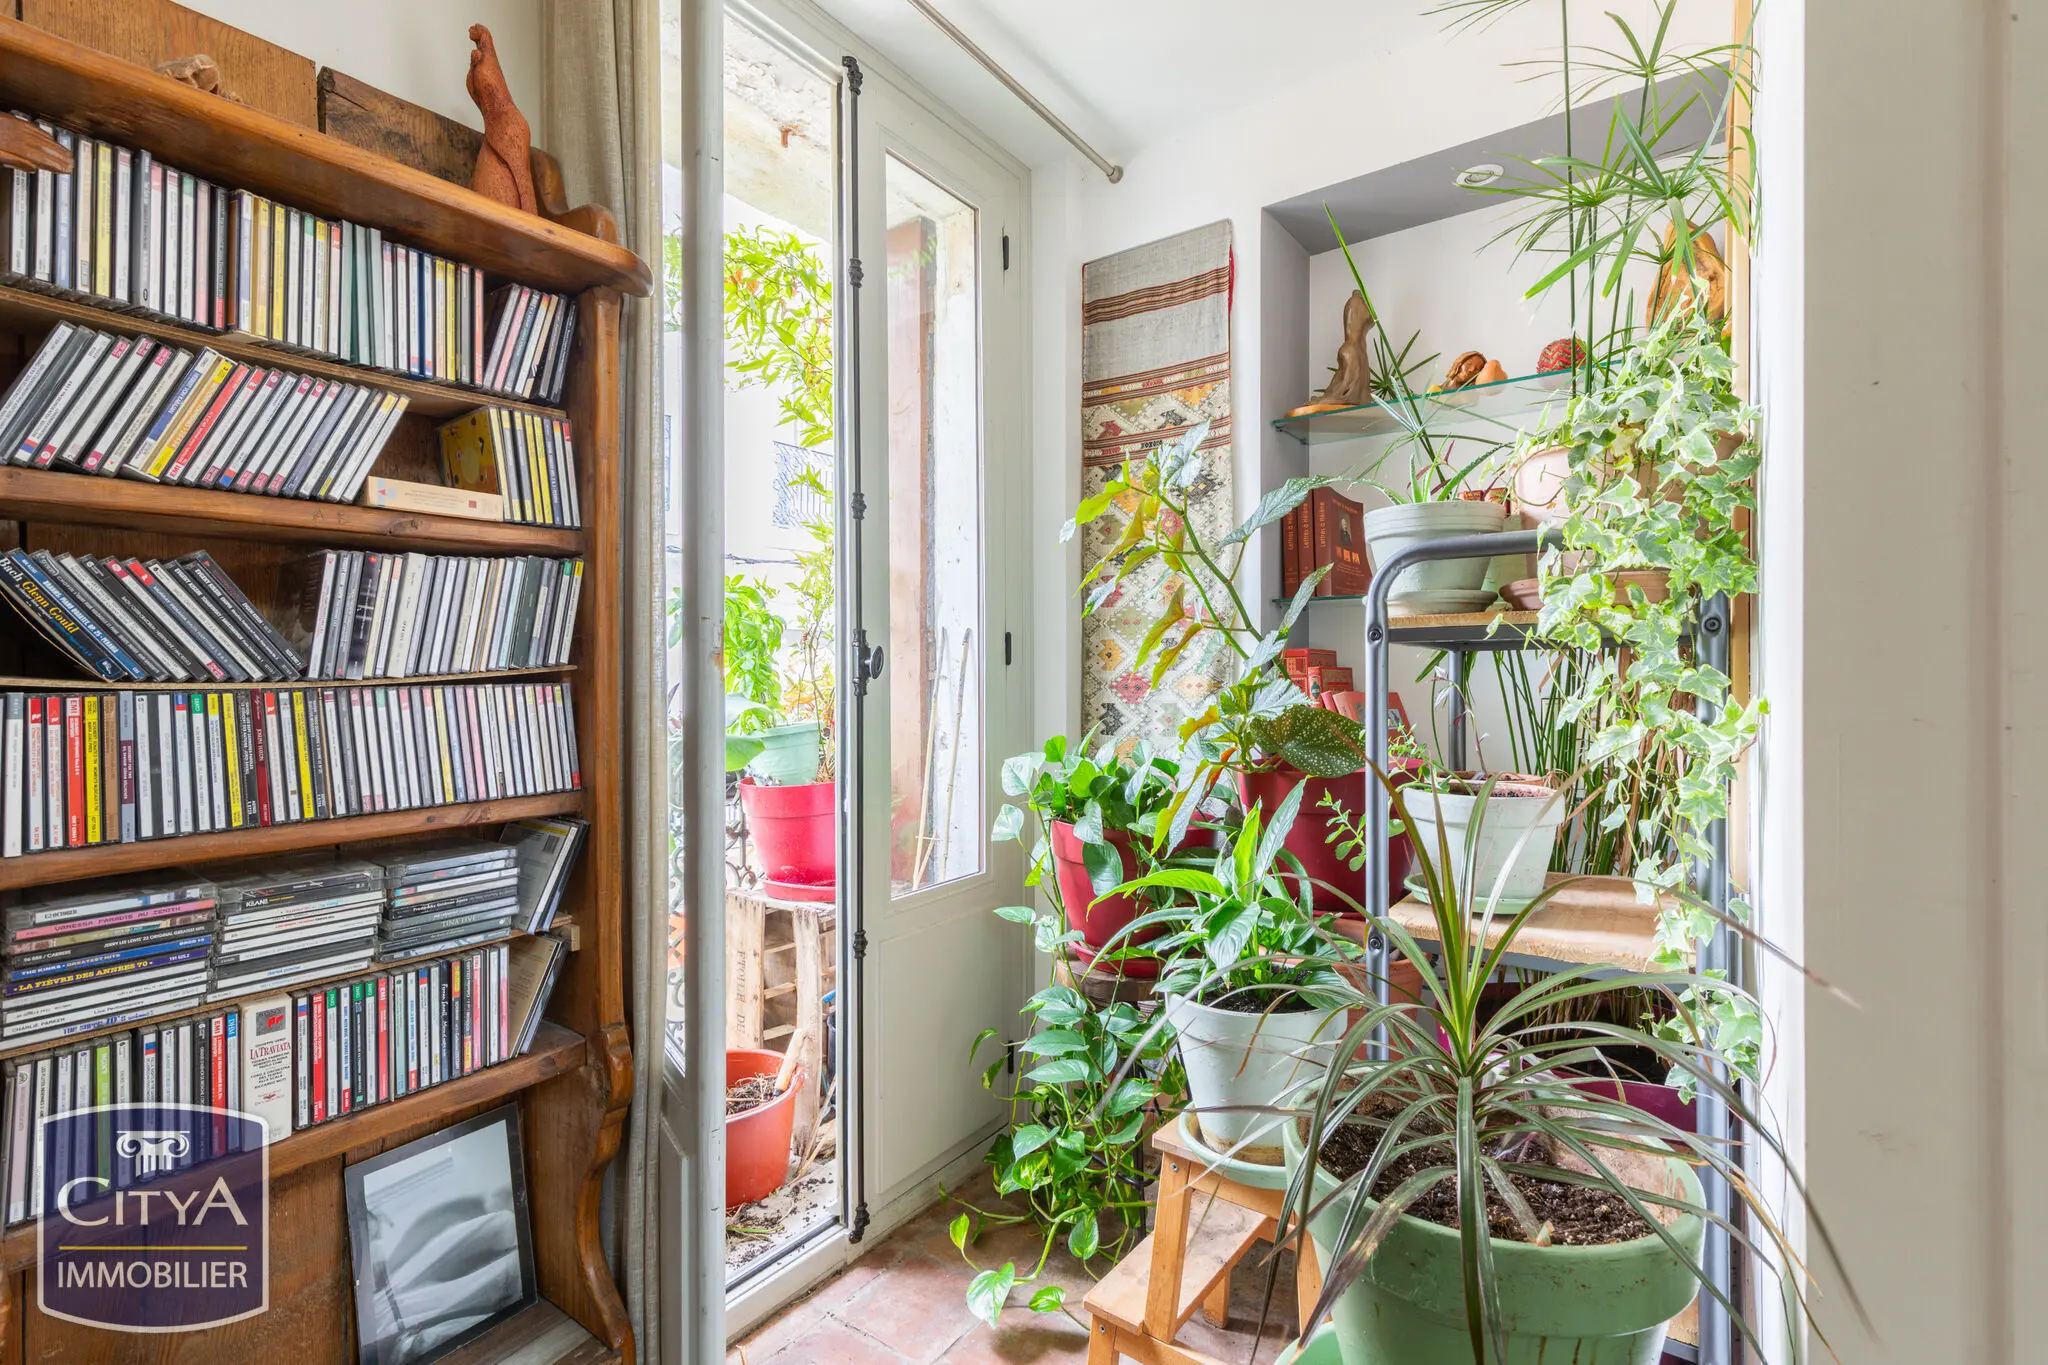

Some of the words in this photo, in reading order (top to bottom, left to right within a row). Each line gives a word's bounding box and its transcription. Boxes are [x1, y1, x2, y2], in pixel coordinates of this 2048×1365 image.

[0, 556, 25, 583] Bach
[19, 577, 52, 610] Glenn
[47, 604, 79, 635] Gould
[69, 699, 77, 713] EMI
[244, 898, 269, 907] KEANE
[53, 920, 93, 931] VANESSA
[97, 914, 133, 924] PARADIS
[152, 906, 181, 915] ZENITH
[103, 940, 119, 948] JERRY
[149, 931, 173, 939] ORIGINAL
[173, 927, 195, 935] GREATEST
[37, 964, 61, 972] KINKS
[65, 956, 103, 967] GREATEST
[17, 983, 33, 991] LA
[34, 974, 74, 988] FIÈVRE
[74, 971, 94, 980] DES
[136, 960, 149, 968] 70
[105, 999, 144, 1012] Performances
[11, 1022, 39, 1033] CHARLIE
[39, 1016, 66, 1026] PARKER
[250, 1048, 260, 1060] LA
[260, 1042, 291, 1058] TRAVIATA
[270, 1074, 283, 1082] SCALA
